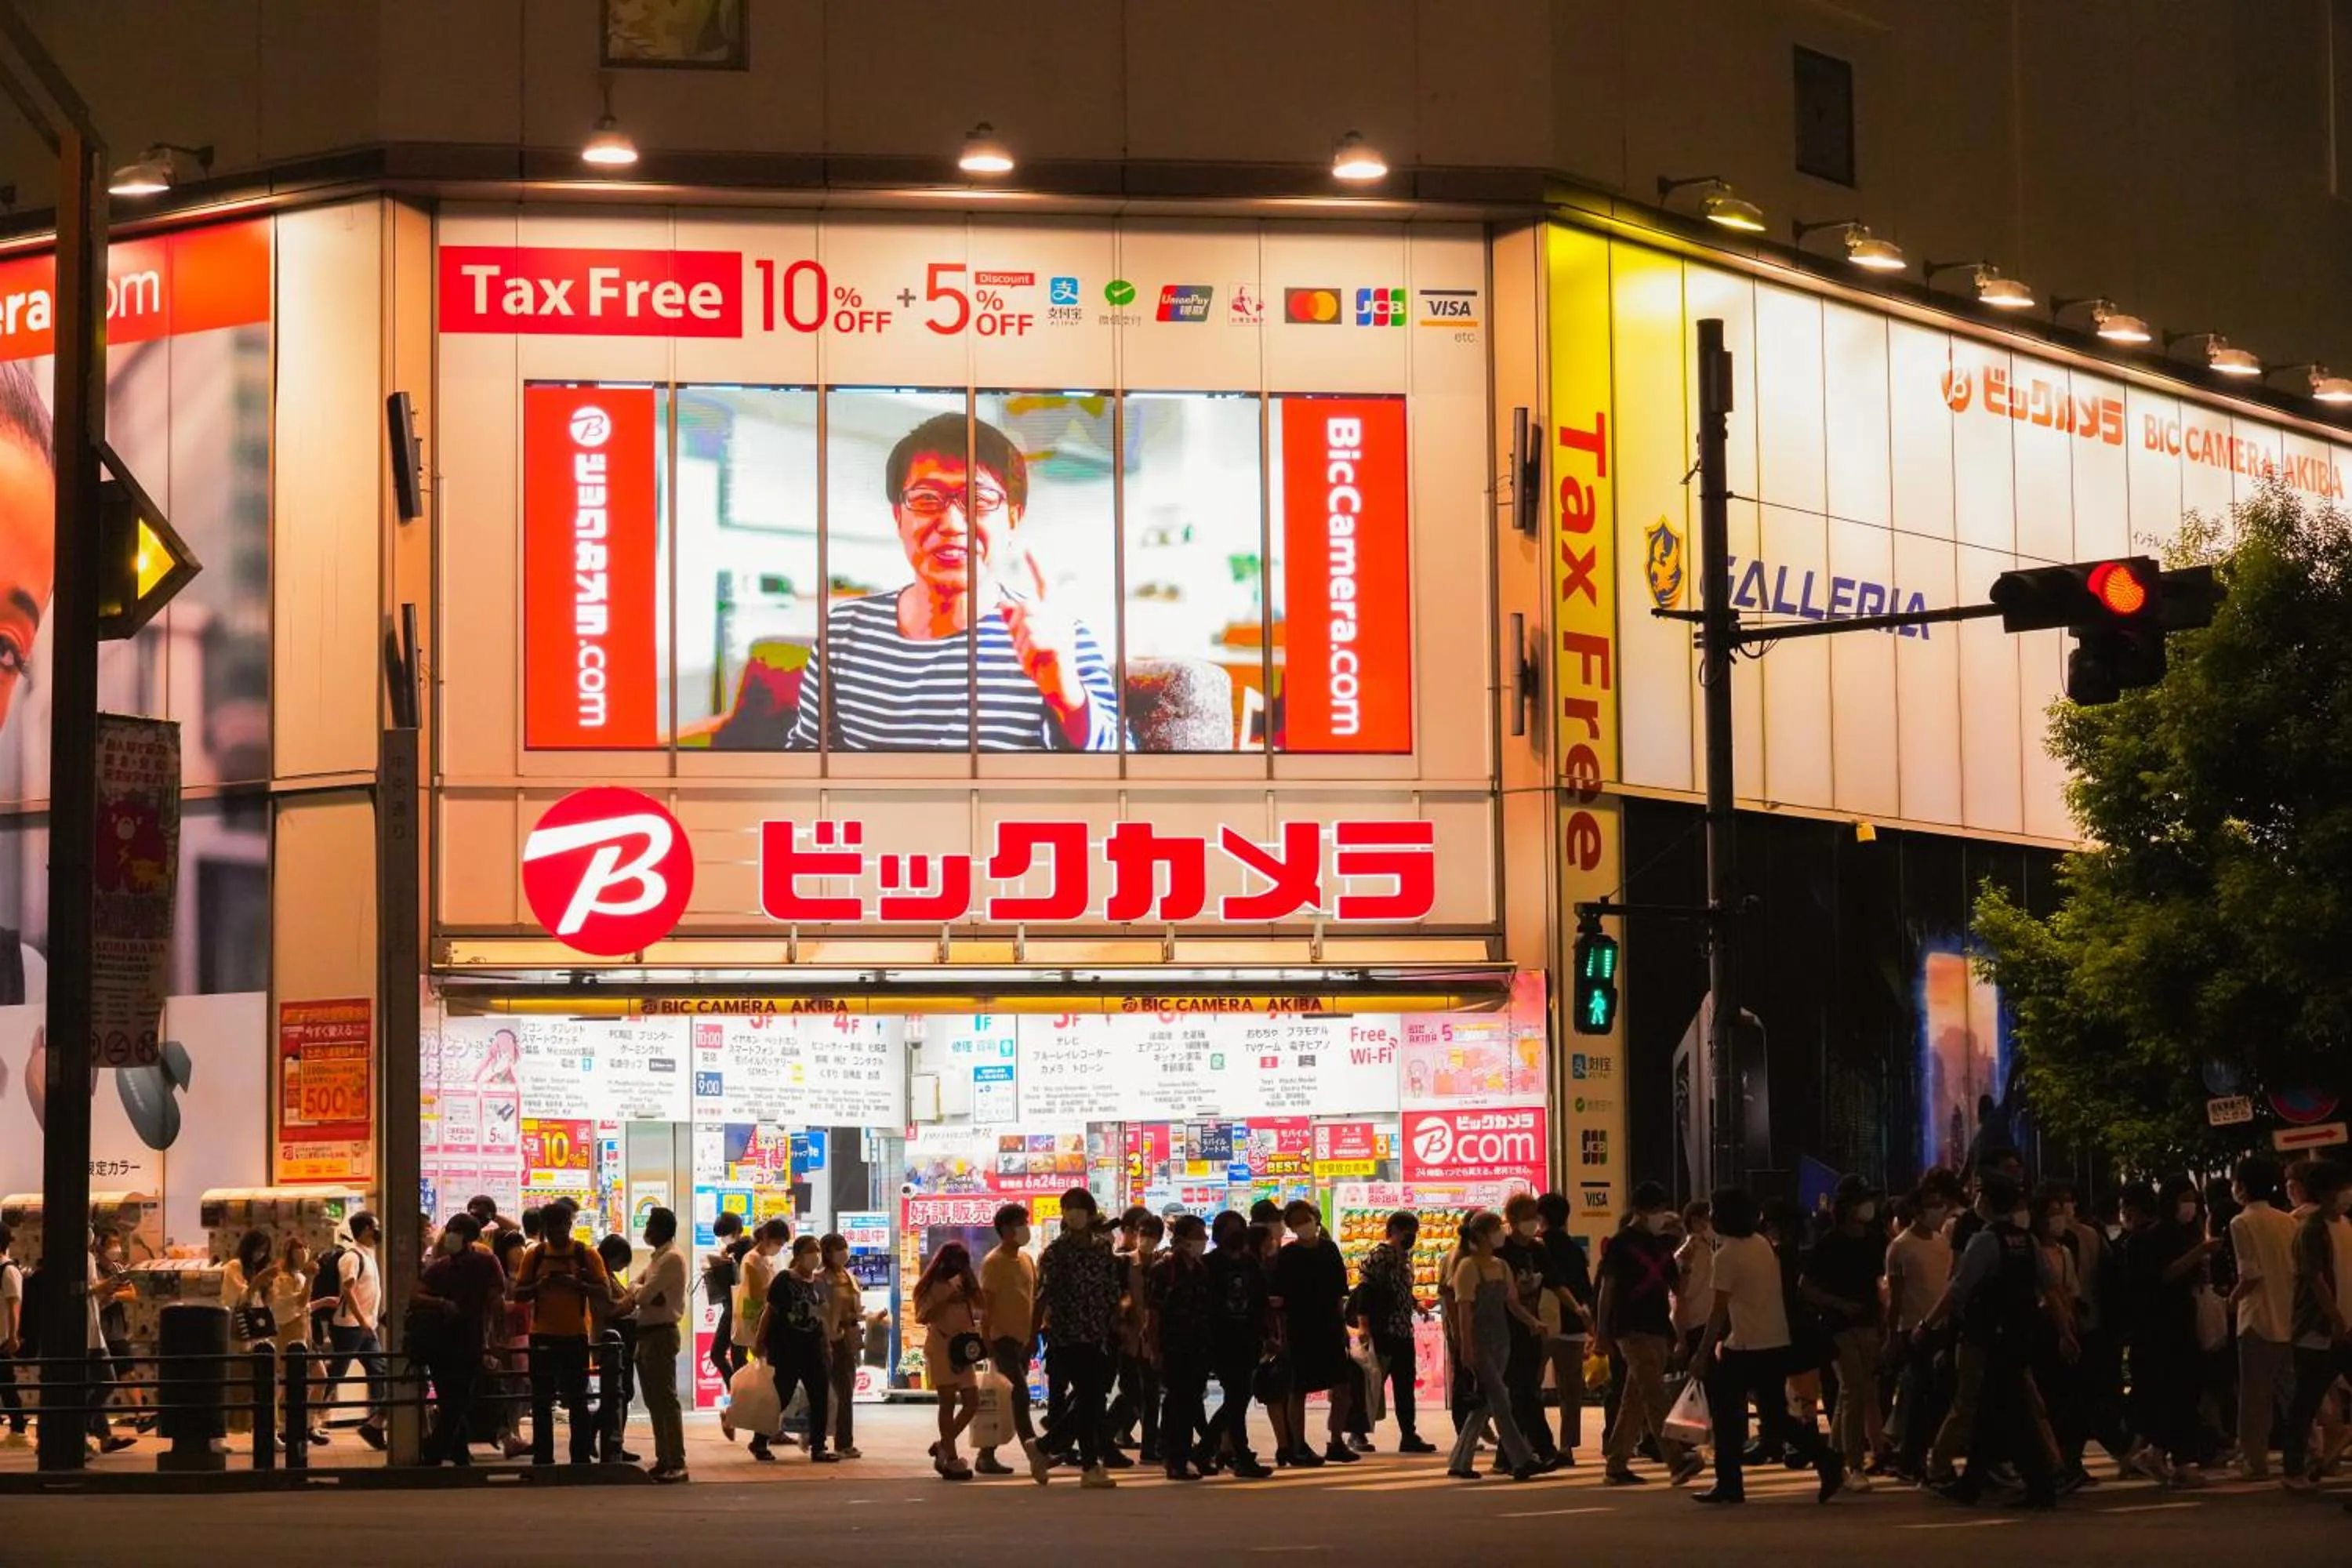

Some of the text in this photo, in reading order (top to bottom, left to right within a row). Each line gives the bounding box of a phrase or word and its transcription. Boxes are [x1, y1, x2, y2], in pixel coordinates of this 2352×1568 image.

[980, 274, 1030, 285] Discount
[462, 264, 723, 320] Tax Free
[755, 260, 829, 333] 10
[1161, 293, 1210, 306] UnionPay
[0, 289, 51, 336] ra
[1356, 300, 1406, 314] JCB
[1427, 300, 1472, 317] VISA
[833, 310, 1034, 336] OFF OFF
[1454, 332, 1479, 343] etc.
[1983, 365, 2123, 446] ビックカメラ
[2144, 413, 2180, 456] BIC
[2283, 452, 2345, 500] AKIBA
[1327, 417, 1363, 735] BicCamera.com
[1559, 412, 1610, 872] Tax Free
[760, 819, 1436, 924] ビックカメラ
[661, 1000, 691, 1013] BIC
[696, 1000, 777, 1014] CAMERA
[789, 999, 849, 1013] AKIBA
[1142, 1000, 1174, 1012] BIC
[1176, 999, 1254, 1012] CAMERA
[1266, 998, 1323, 1011] AKIBA
[1350, 1026, 1387, 1042] Free
[1350, 1047, 1392, 1065] Wi-Fi
[1456, 1113, 1534, 1131] ビックカメラ
[1451, 1132, 1536, 1164] .com
[1583, 1141, 1606, 1153] JCB
[1266, 1161, 1301, 1174] BEST
[1584, 1192, 1608, 1207] VISA
[908, 1199, 1027, 1225] 好評販売
[841, 1229, 886, 1243] 検温中
